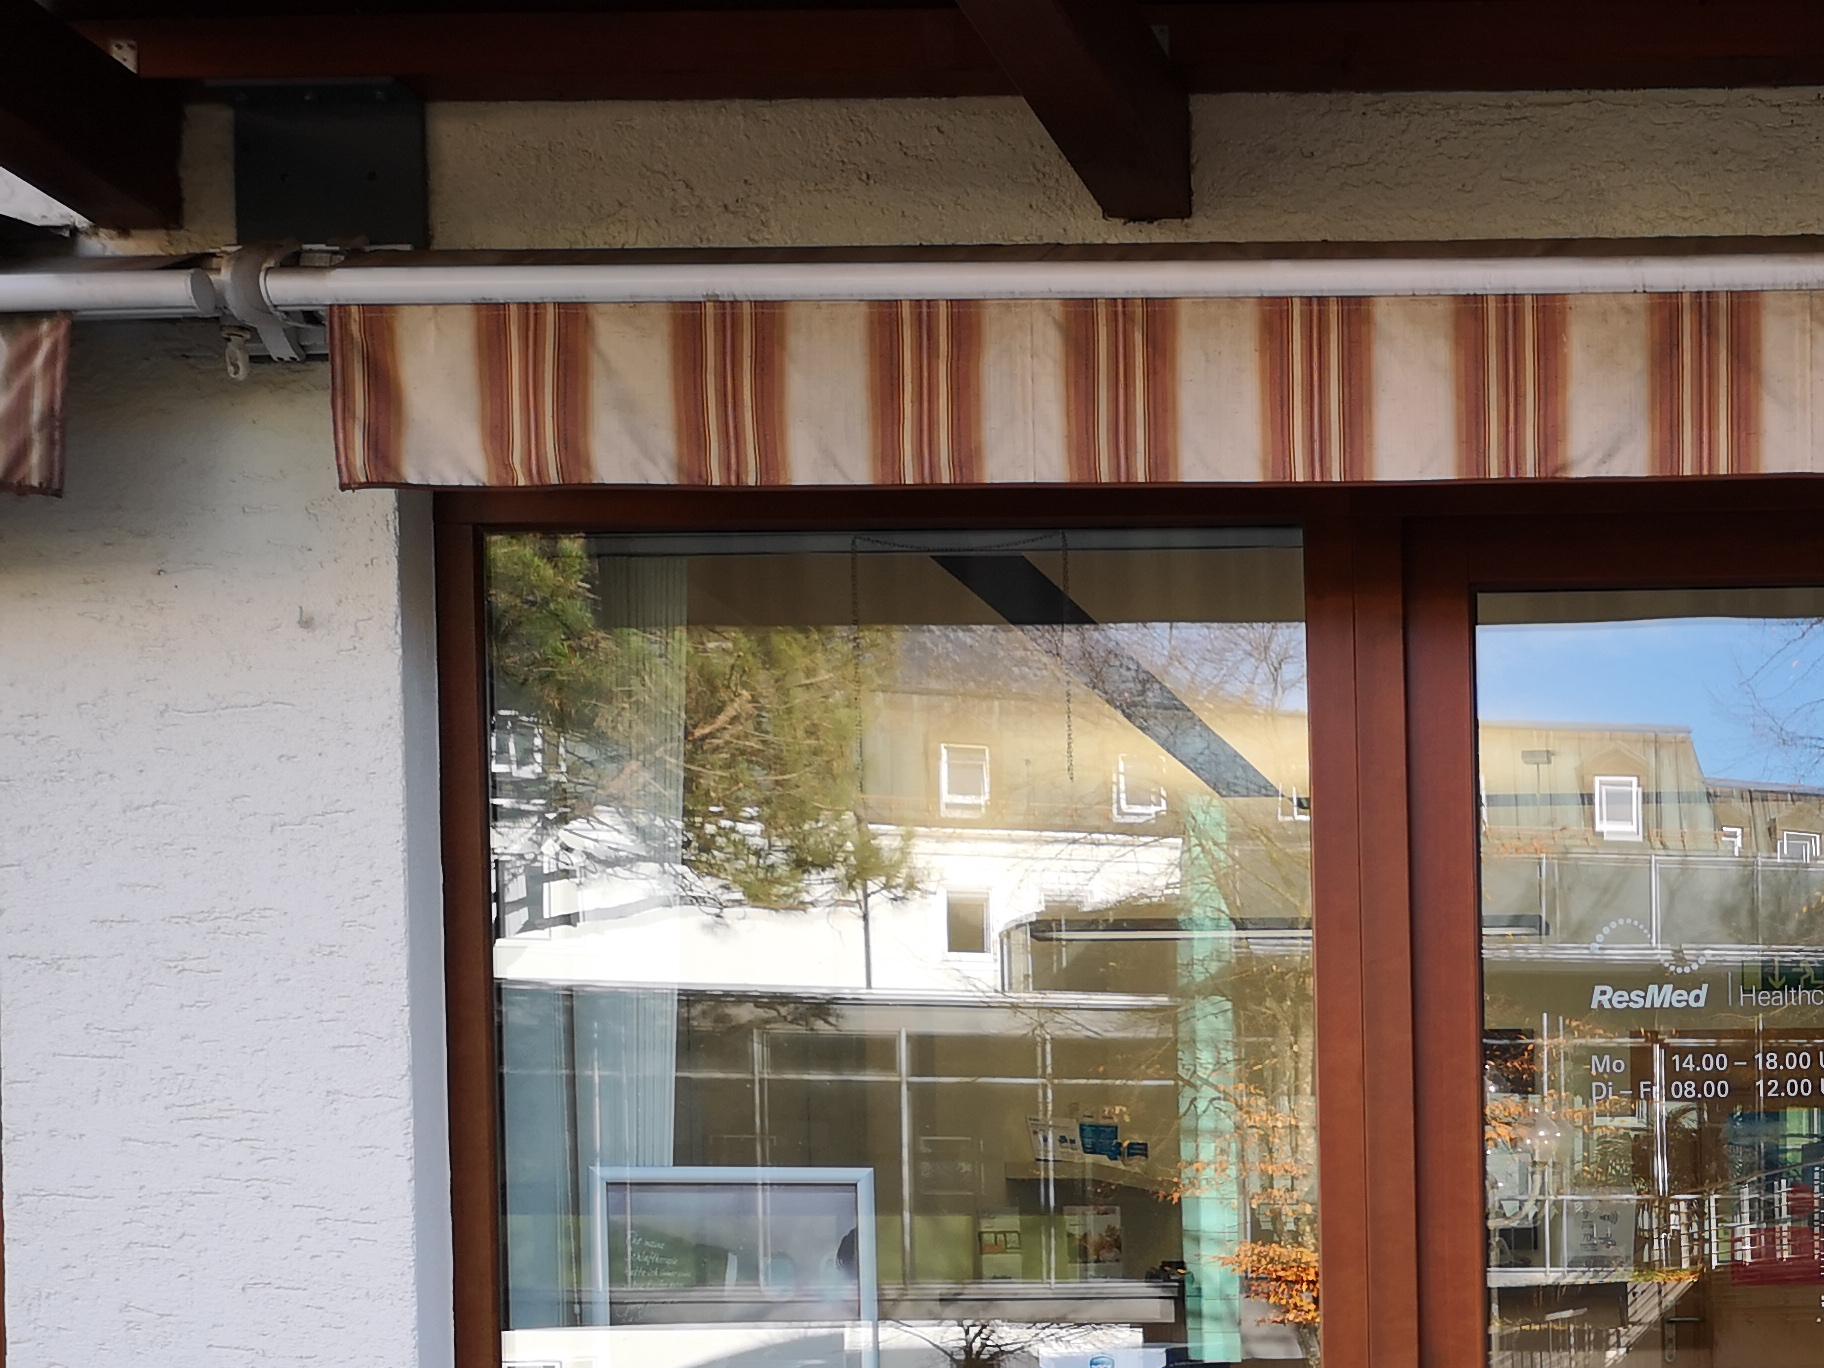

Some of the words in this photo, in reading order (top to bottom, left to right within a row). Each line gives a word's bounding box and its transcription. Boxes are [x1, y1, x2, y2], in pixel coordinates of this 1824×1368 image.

[1591, 983, 1709, 1009] ResMed
[1591, 1055, 1625, 1073] Mo
[1672, 1053, 1728, 1071] 14.00
[1754, 1052, 1811, 1070] 18.00
[1591, 1081, 1613, 1102] Di
[1671, 1080, 1729, 1099] 08.00
[1755, 1079, 1813, 1098] 12.00
